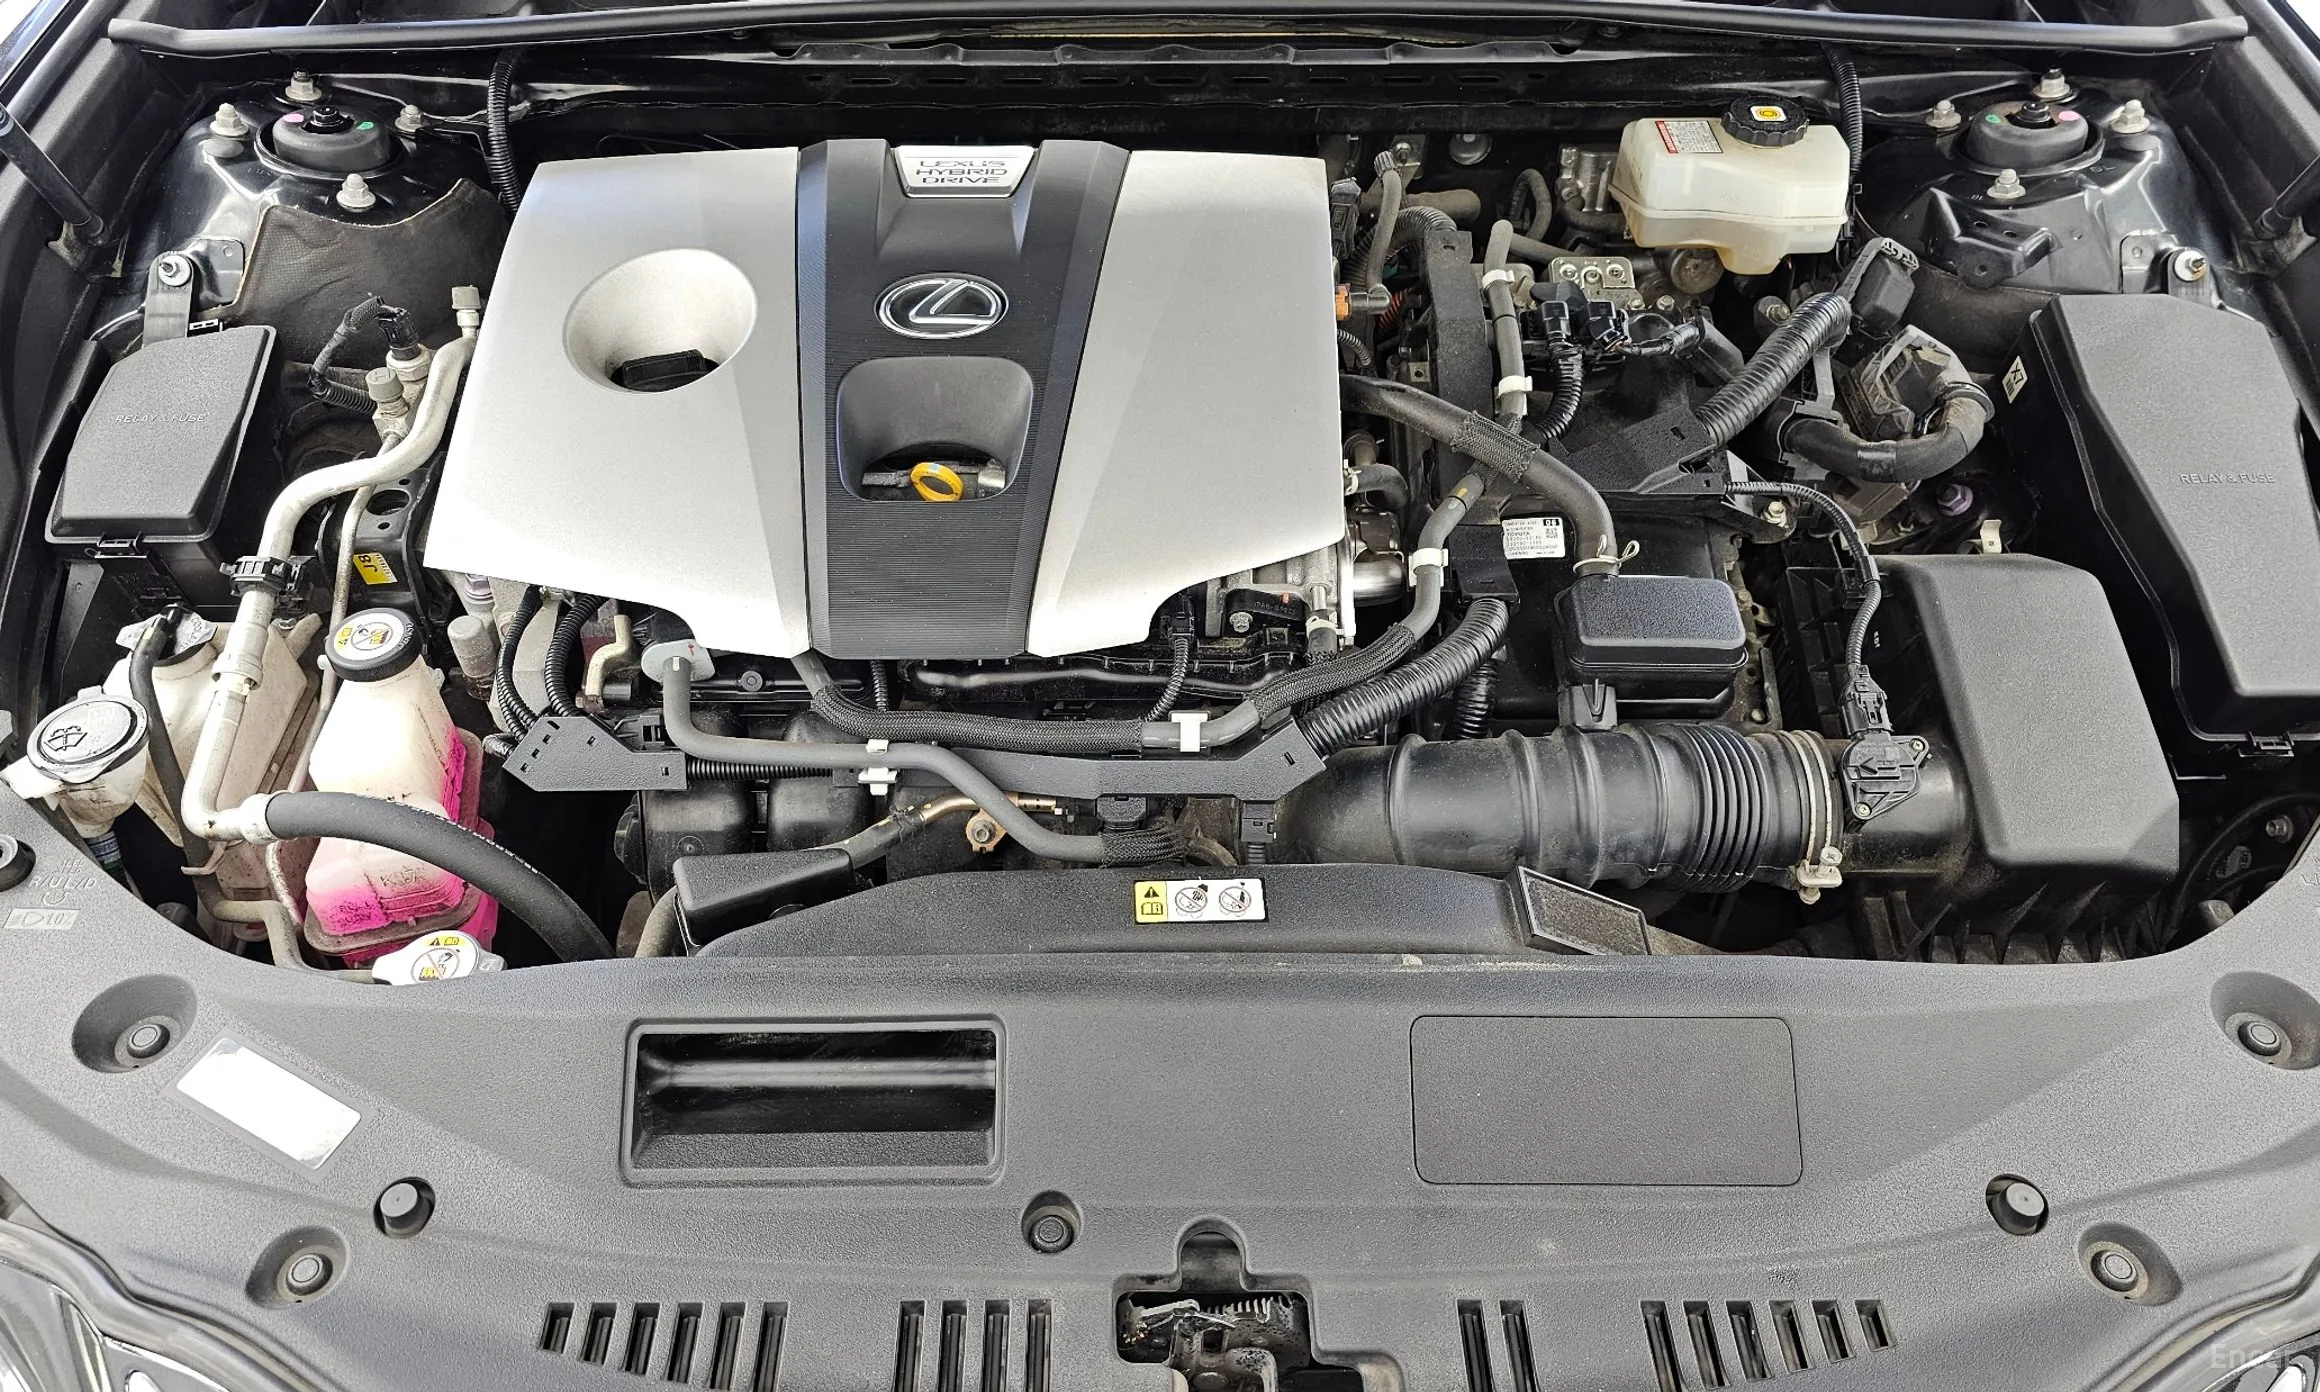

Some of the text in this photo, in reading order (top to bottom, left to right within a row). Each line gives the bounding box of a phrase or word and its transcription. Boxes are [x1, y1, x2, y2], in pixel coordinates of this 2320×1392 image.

[915, 168, 1008, 176] HYBRID
[114, 413, 160, 423] RELAY
[171, 412, 206, 423] FUSE
[2178, 472, 2277, 485] RELAY & FUSE
